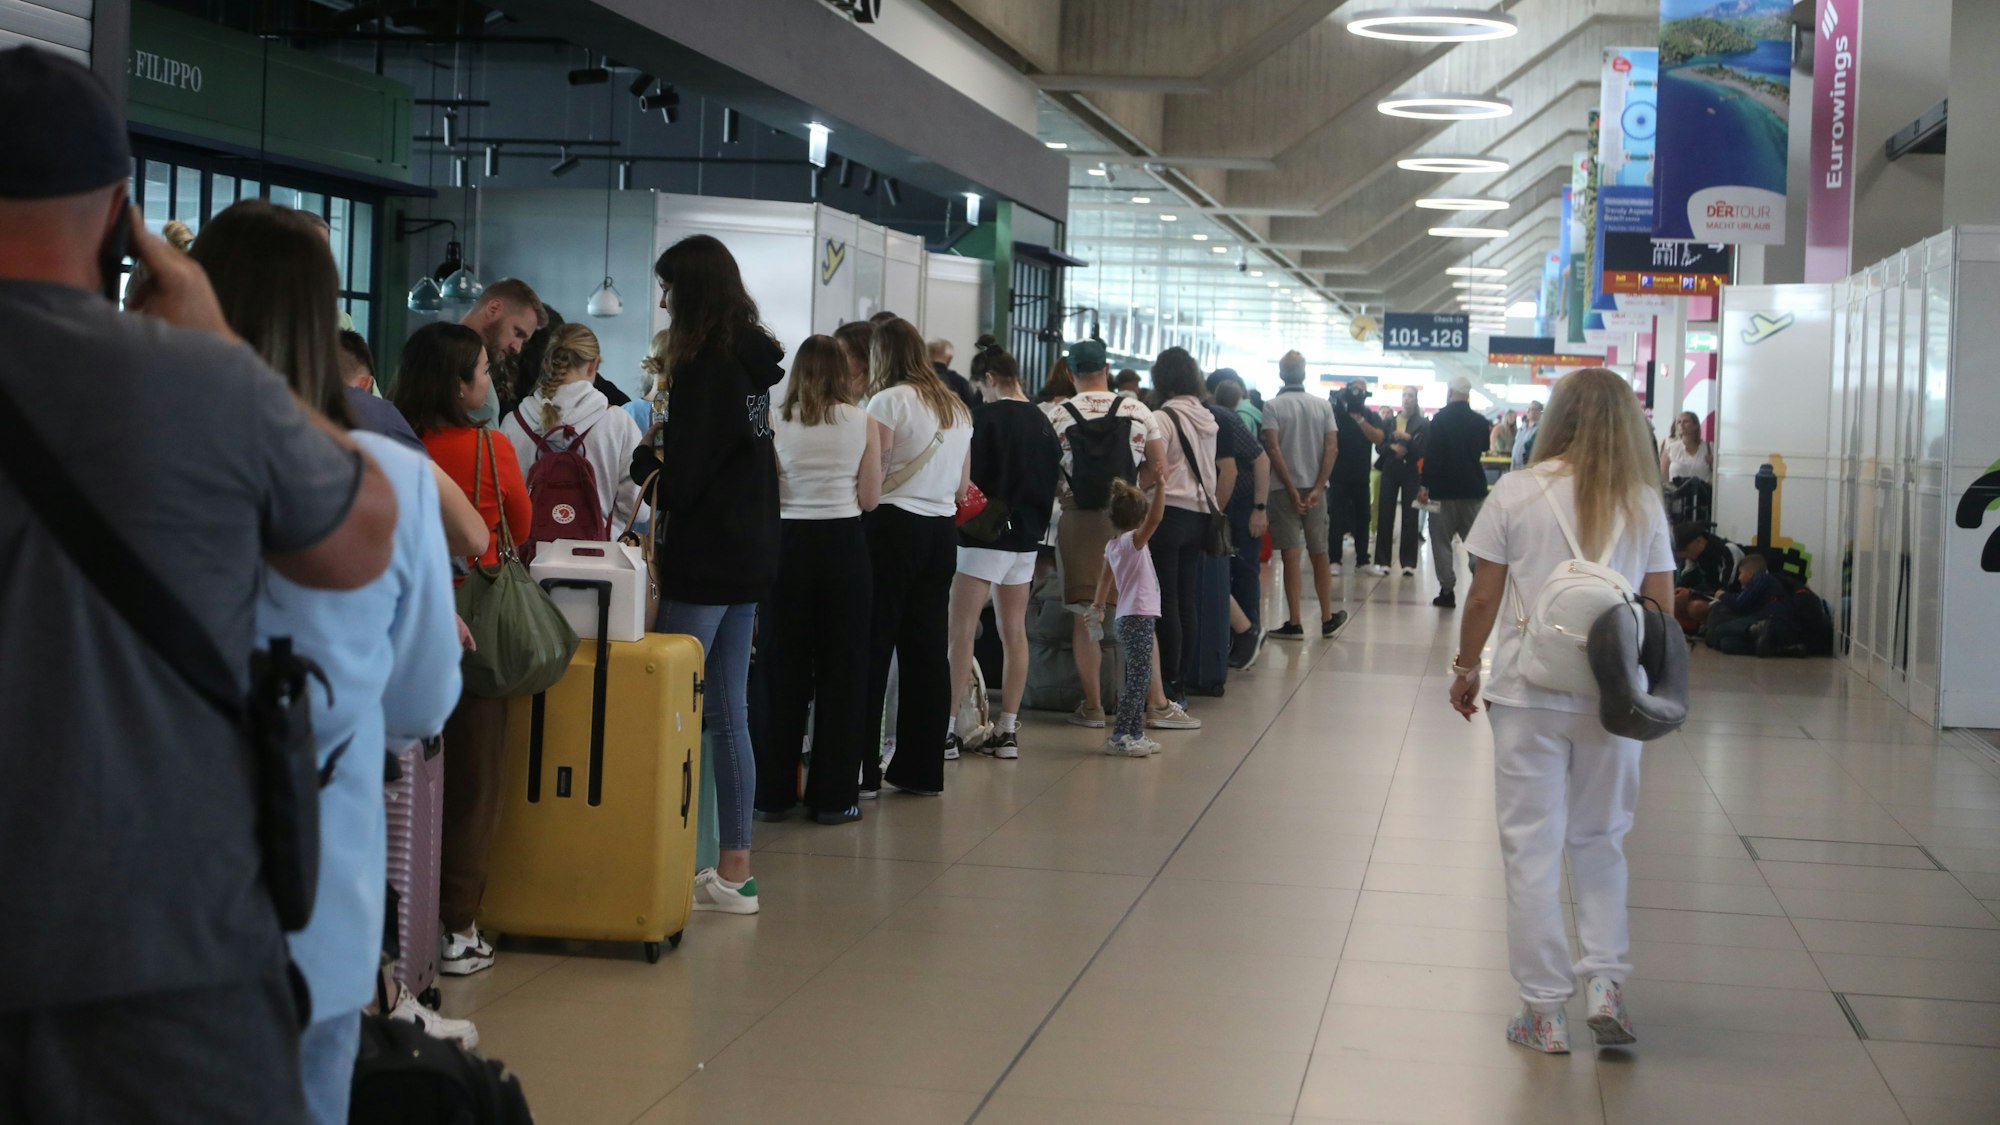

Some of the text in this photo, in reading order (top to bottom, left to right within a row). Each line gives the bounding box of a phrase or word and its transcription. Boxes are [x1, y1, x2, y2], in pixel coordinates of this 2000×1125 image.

[135, 49, 202, 93] FILIPPO
[1826, 35, 1851, 189] Eurowings
[1706, 203, 1771, 219] DERTOUR
[1706, 222, 1771, 231] MACHT URLAUB
[1434, 315, 1464, 324] Check-in
[1389, 328, 1463, 348] 101-126
